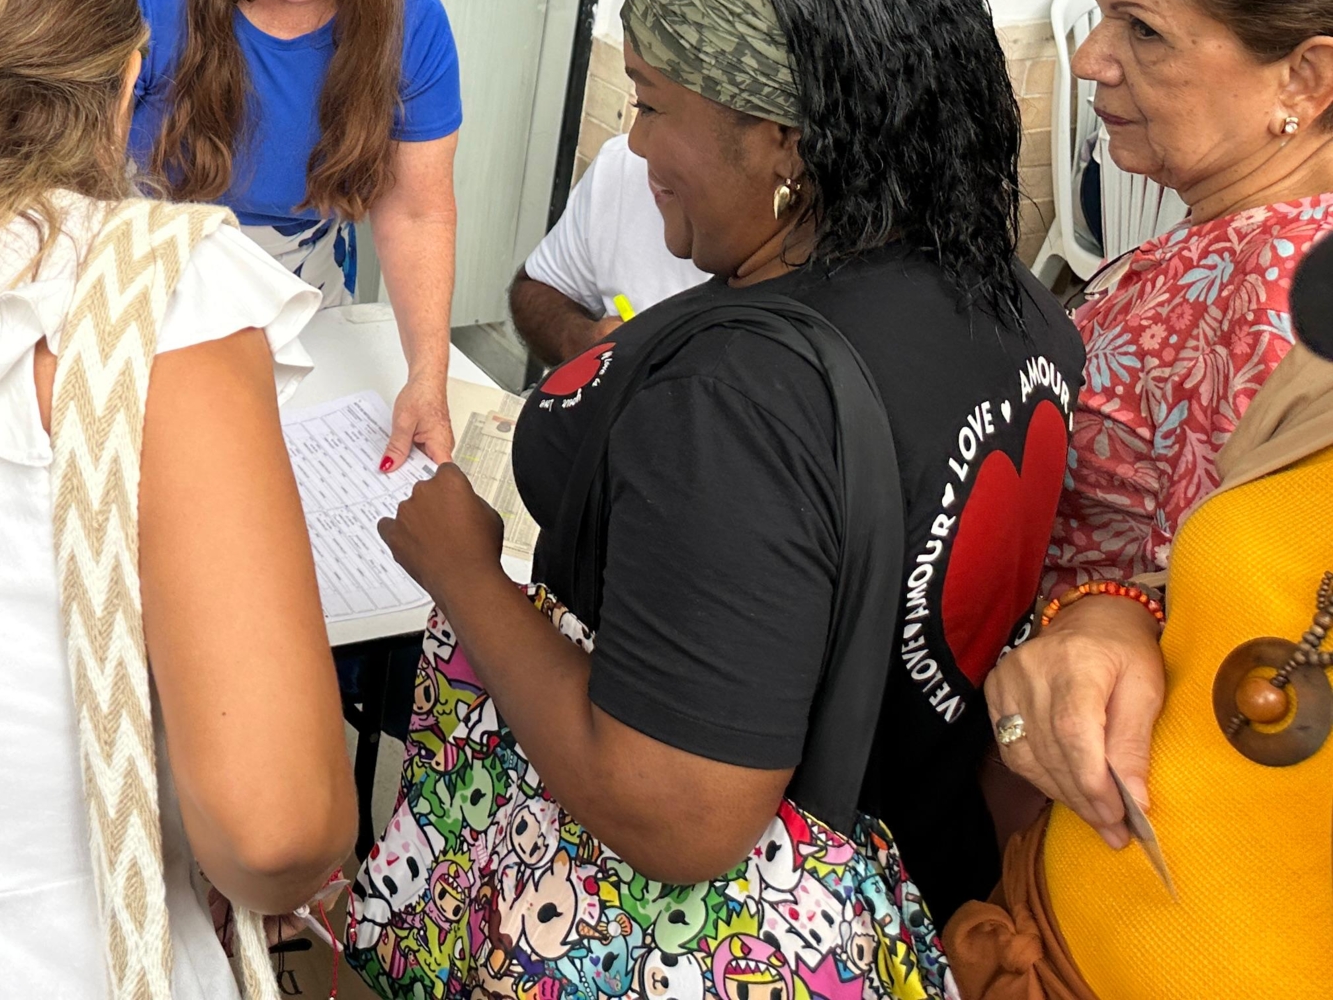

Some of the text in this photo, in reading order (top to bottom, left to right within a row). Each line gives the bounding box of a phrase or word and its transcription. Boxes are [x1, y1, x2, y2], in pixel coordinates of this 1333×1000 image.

[1019, 356, 1070, 414] AMOUR
[948, 401, 995, 482] LOVE
[905, 513, 957, 621] AMOUR
[901, 635, 944, 693] LOVE
